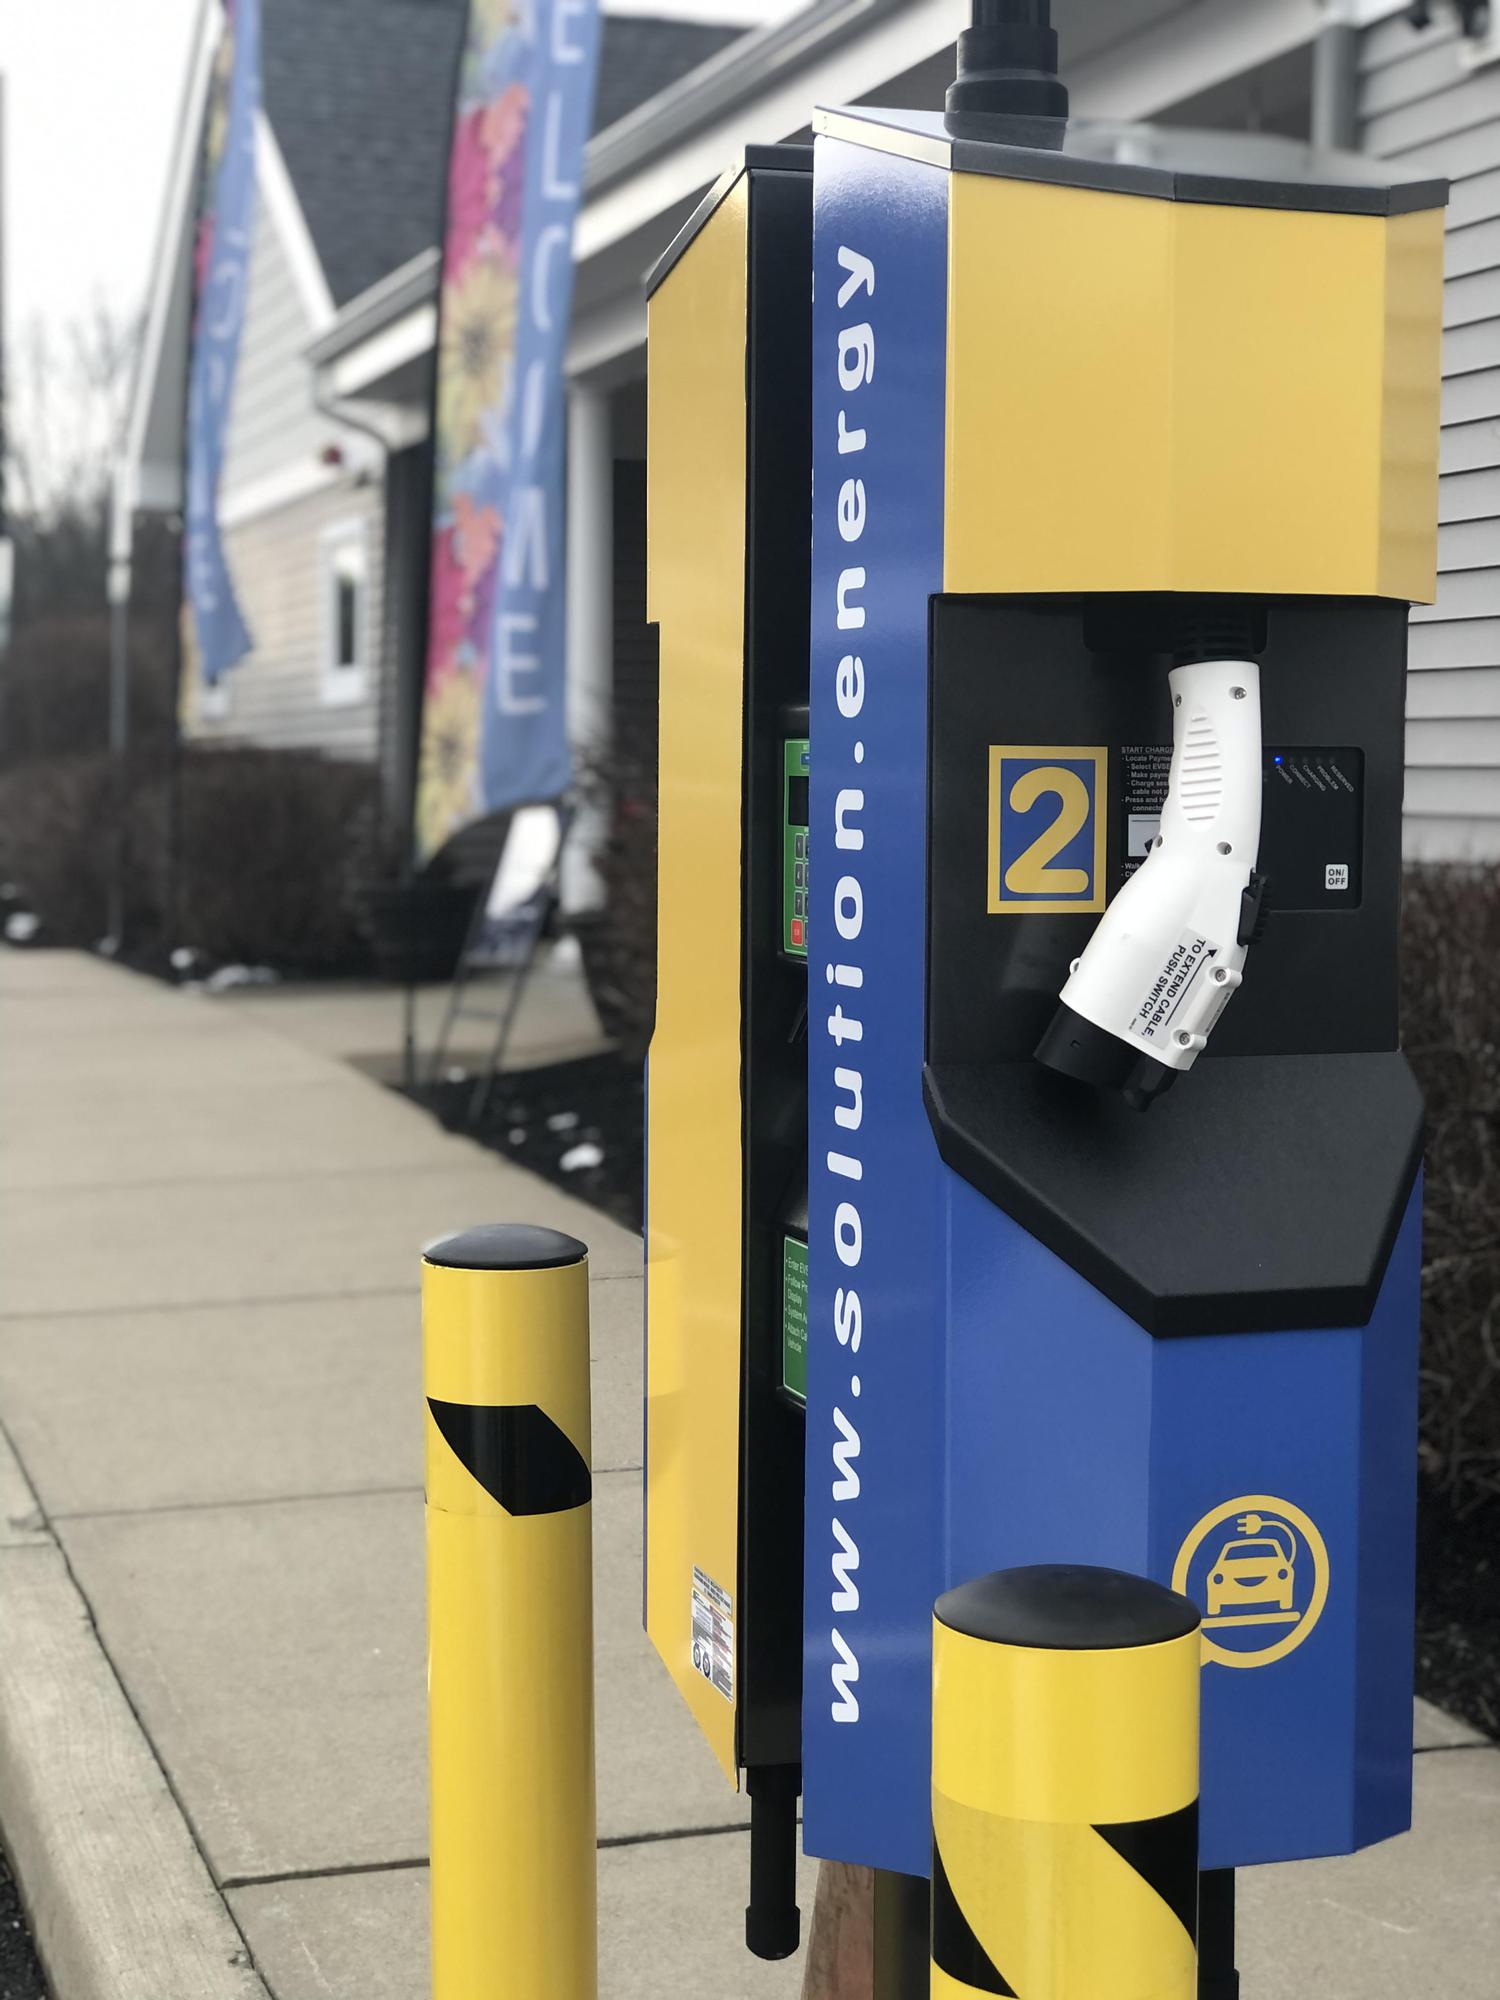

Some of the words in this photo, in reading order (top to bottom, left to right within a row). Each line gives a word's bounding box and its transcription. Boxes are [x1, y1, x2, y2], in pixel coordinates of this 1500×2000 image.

[1121, 746, 1143, 754] START
[1131, 780, 1154, 788] Charge
[1276, 764, 1293, 784] POWER
[1289, 764, 1311, 788] CONNECT
[1303, 764, 1326, 791] CHARGING
[1317, 765, 1339, 790] PROBLEM
[1331, 765, 1354, 792] RESERVED
[1005, 766, 1090, 894] 2
[1328, 868, 1345, 877] ON/
[1328, 877, 1346, 886] OFF
[1191, 938, 1207, 955] TO
[1163, 944, 1188, 977] PUSH
[826, 245, 875, 1724] www.solution.energy
[1167, 954, 1197, 998] EXTEND
[1139, 976, 1169, 1020] SWITCH
